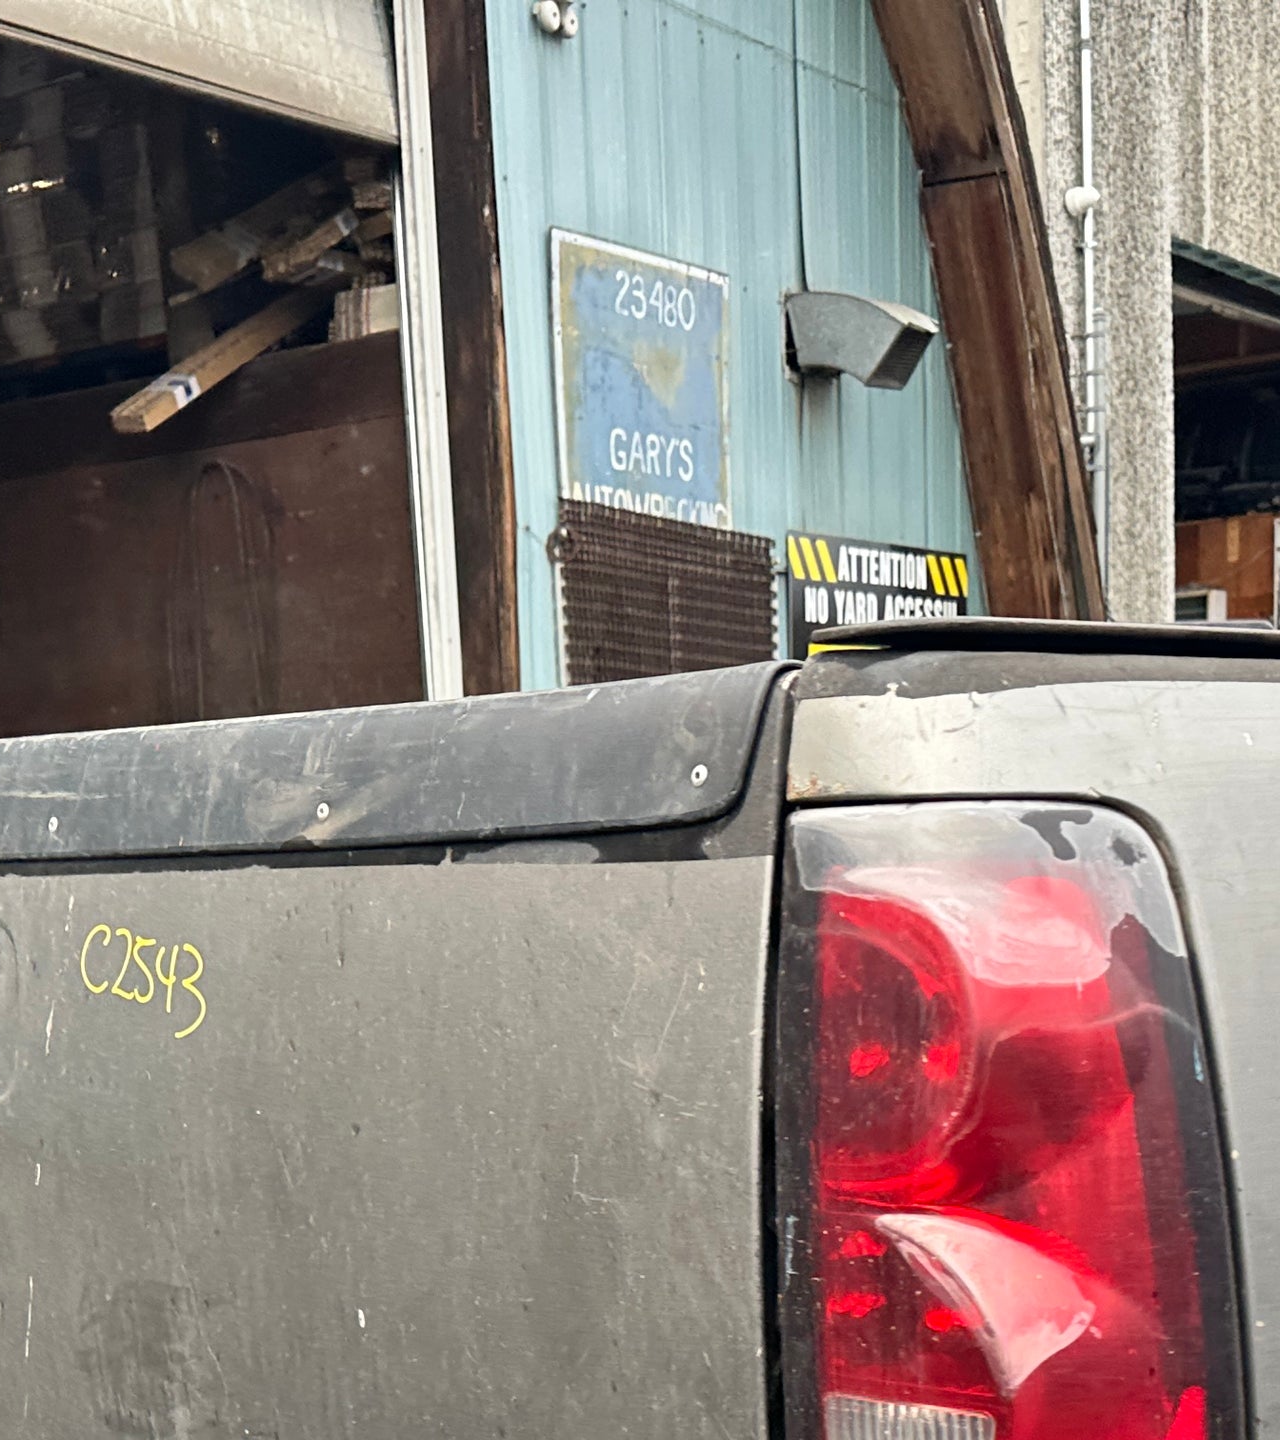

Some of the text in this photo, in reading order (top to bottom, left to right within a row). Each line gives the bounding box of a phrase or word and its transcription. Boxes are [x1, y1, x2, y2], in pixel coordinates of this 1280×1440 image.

[615, 270, 696, 331] 23480
[838, 545, 927, 590] ATTENTION
[804, 586, 829, 624] NO
[834, 588, 878, 625] YARD
[80, 924, 207, 1039] C2543
